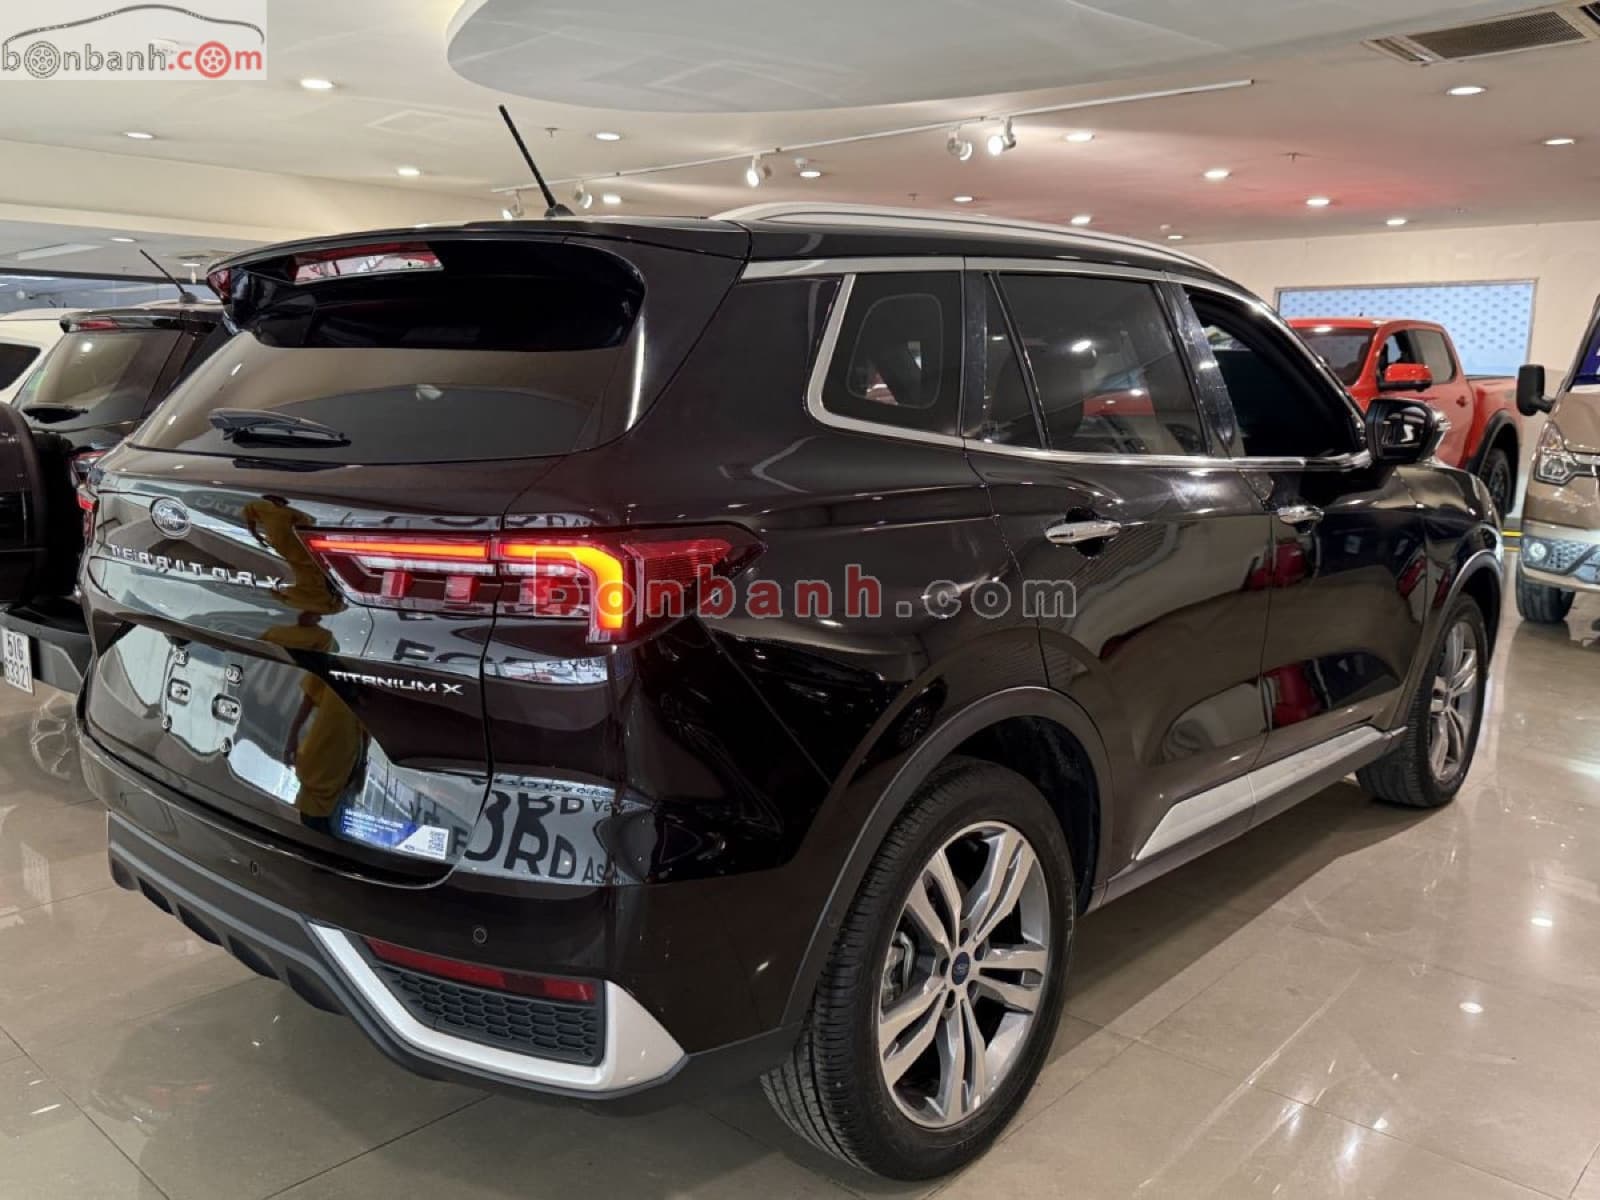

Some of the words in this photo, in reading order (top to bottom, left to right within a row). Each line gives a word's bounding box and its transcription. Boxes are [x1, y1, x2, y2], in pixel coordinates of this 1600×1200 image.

[110, 543, 282, 592] TERRITORY
[329, 670, 437, 692] TITANIUM
[441, 683, 464, 695] X
